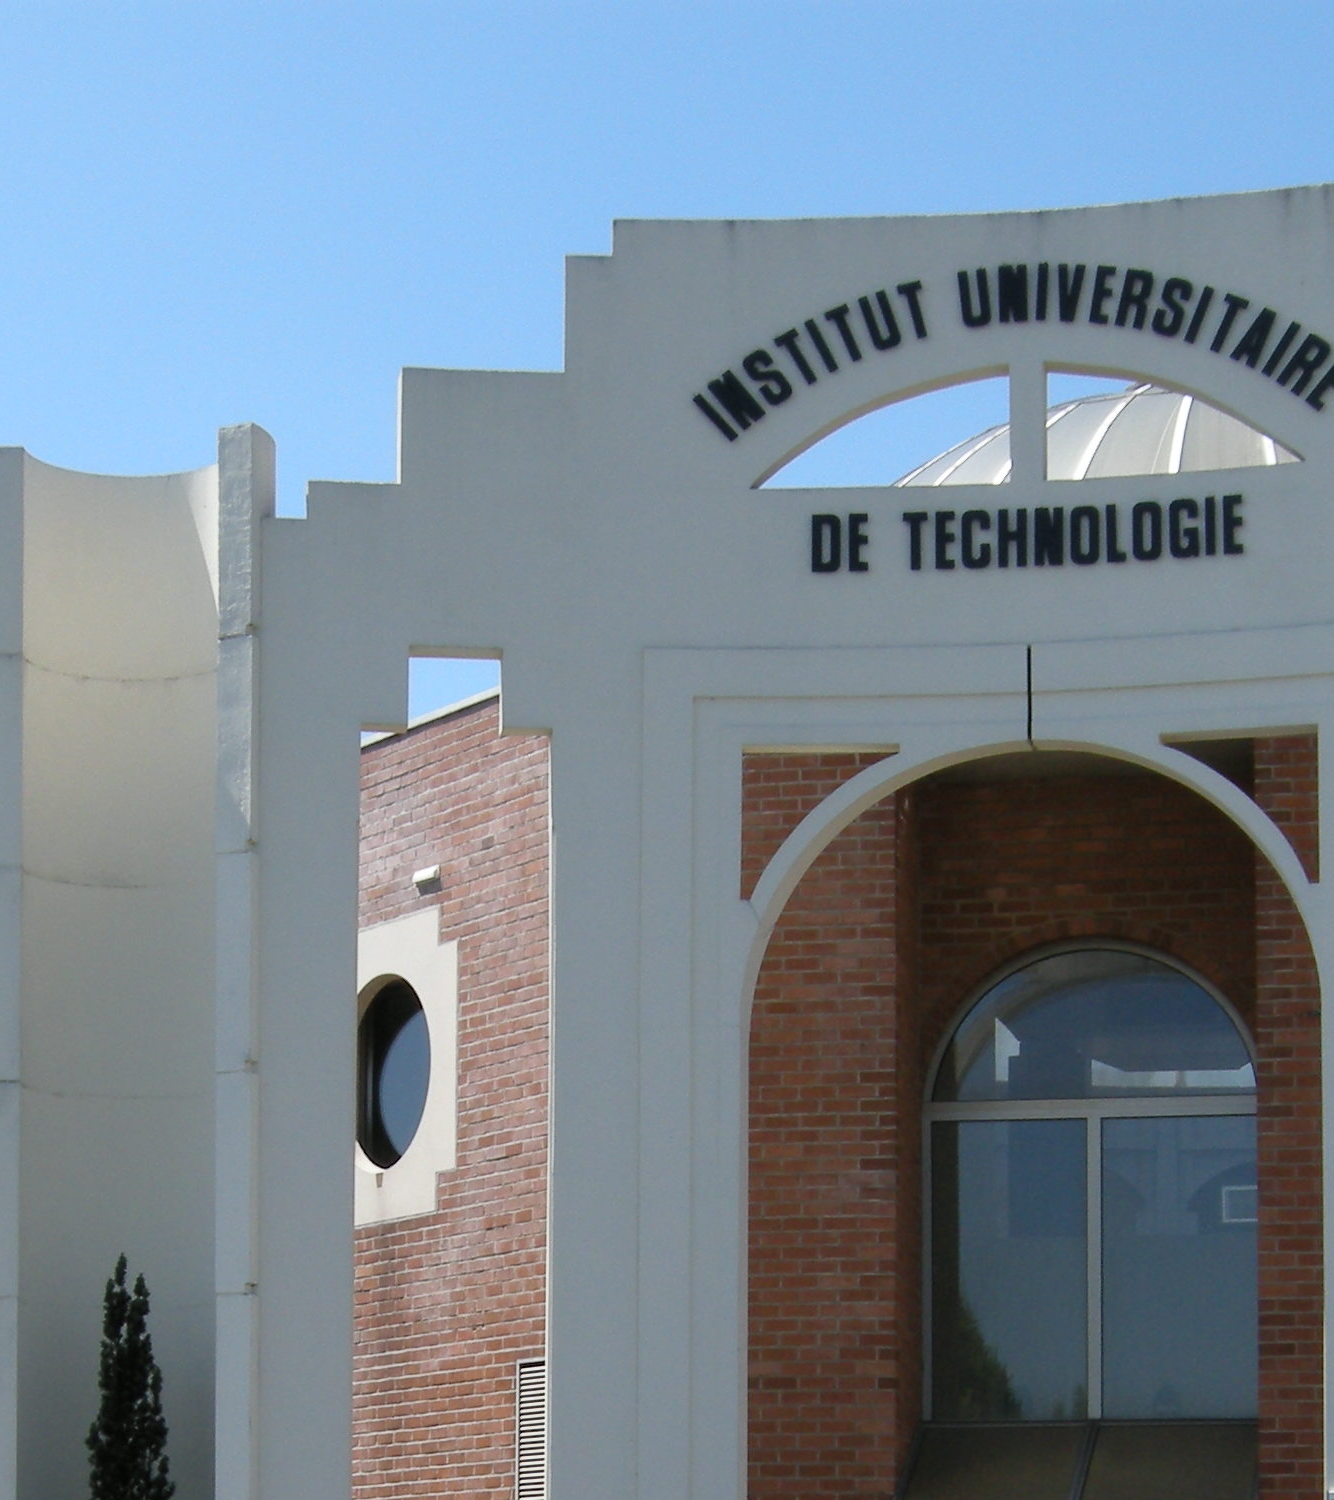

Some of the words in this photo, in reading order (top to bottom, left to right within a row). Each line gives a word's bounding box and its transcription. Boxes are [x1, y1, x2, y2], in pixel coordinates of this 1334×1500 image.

[693, 280, 927, 441] INSTITUT
[811, 513, 868, 573] DE
[903, 495, 1244, 571] TECHNOLOGIE
